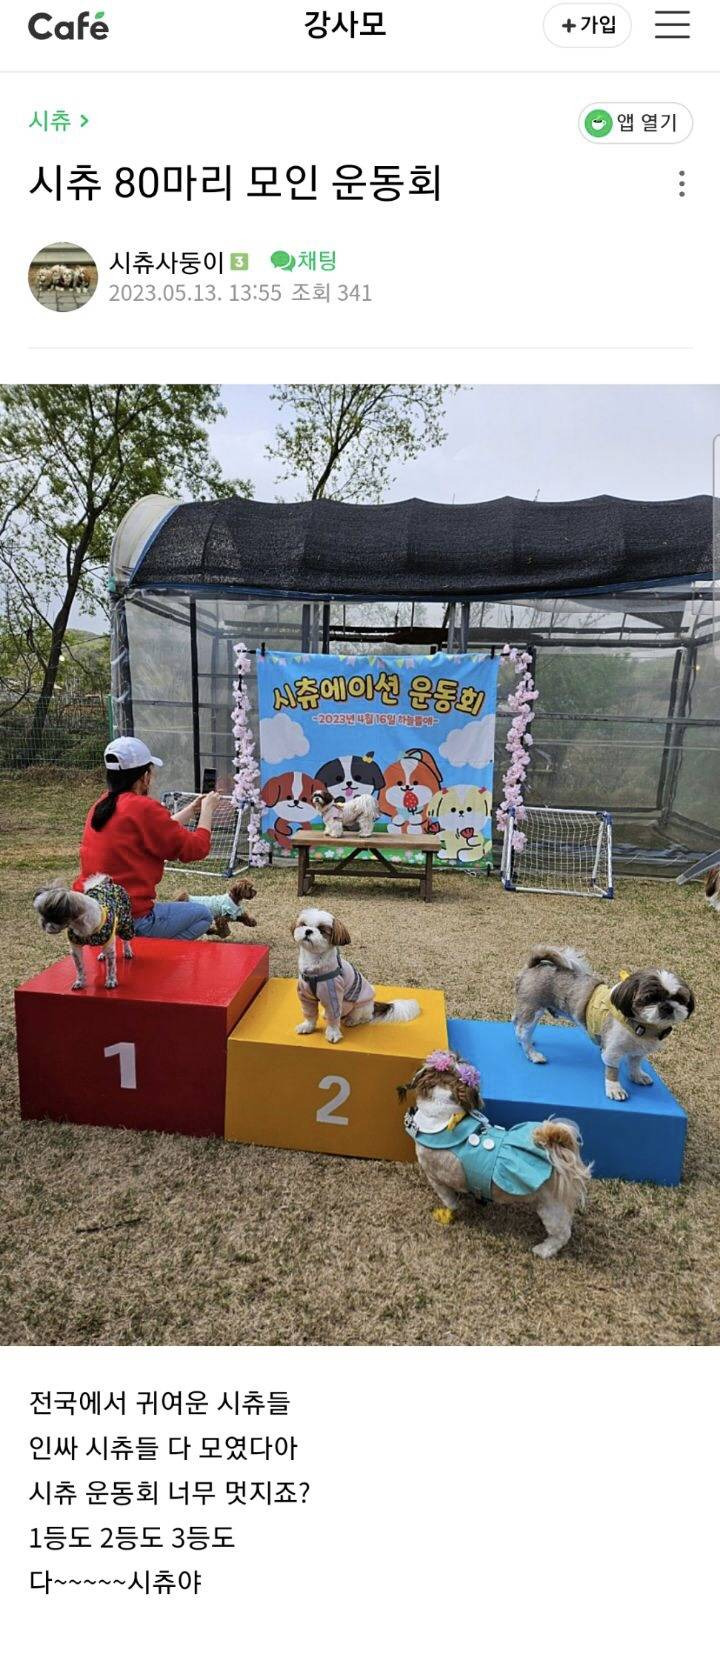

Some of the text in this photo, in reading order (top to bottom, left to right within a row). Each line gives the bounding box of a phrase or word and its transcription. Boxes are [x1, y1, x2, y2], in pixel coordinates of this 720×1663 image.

[273, 672, 485, 716] 시츄에이션 운동회
[357, 712, 374, 726] 4월
[375, 713, 396, 726] 16일
[104, 1042, 137, 1089] 1
[316, 1075, 350, 1125] 2
